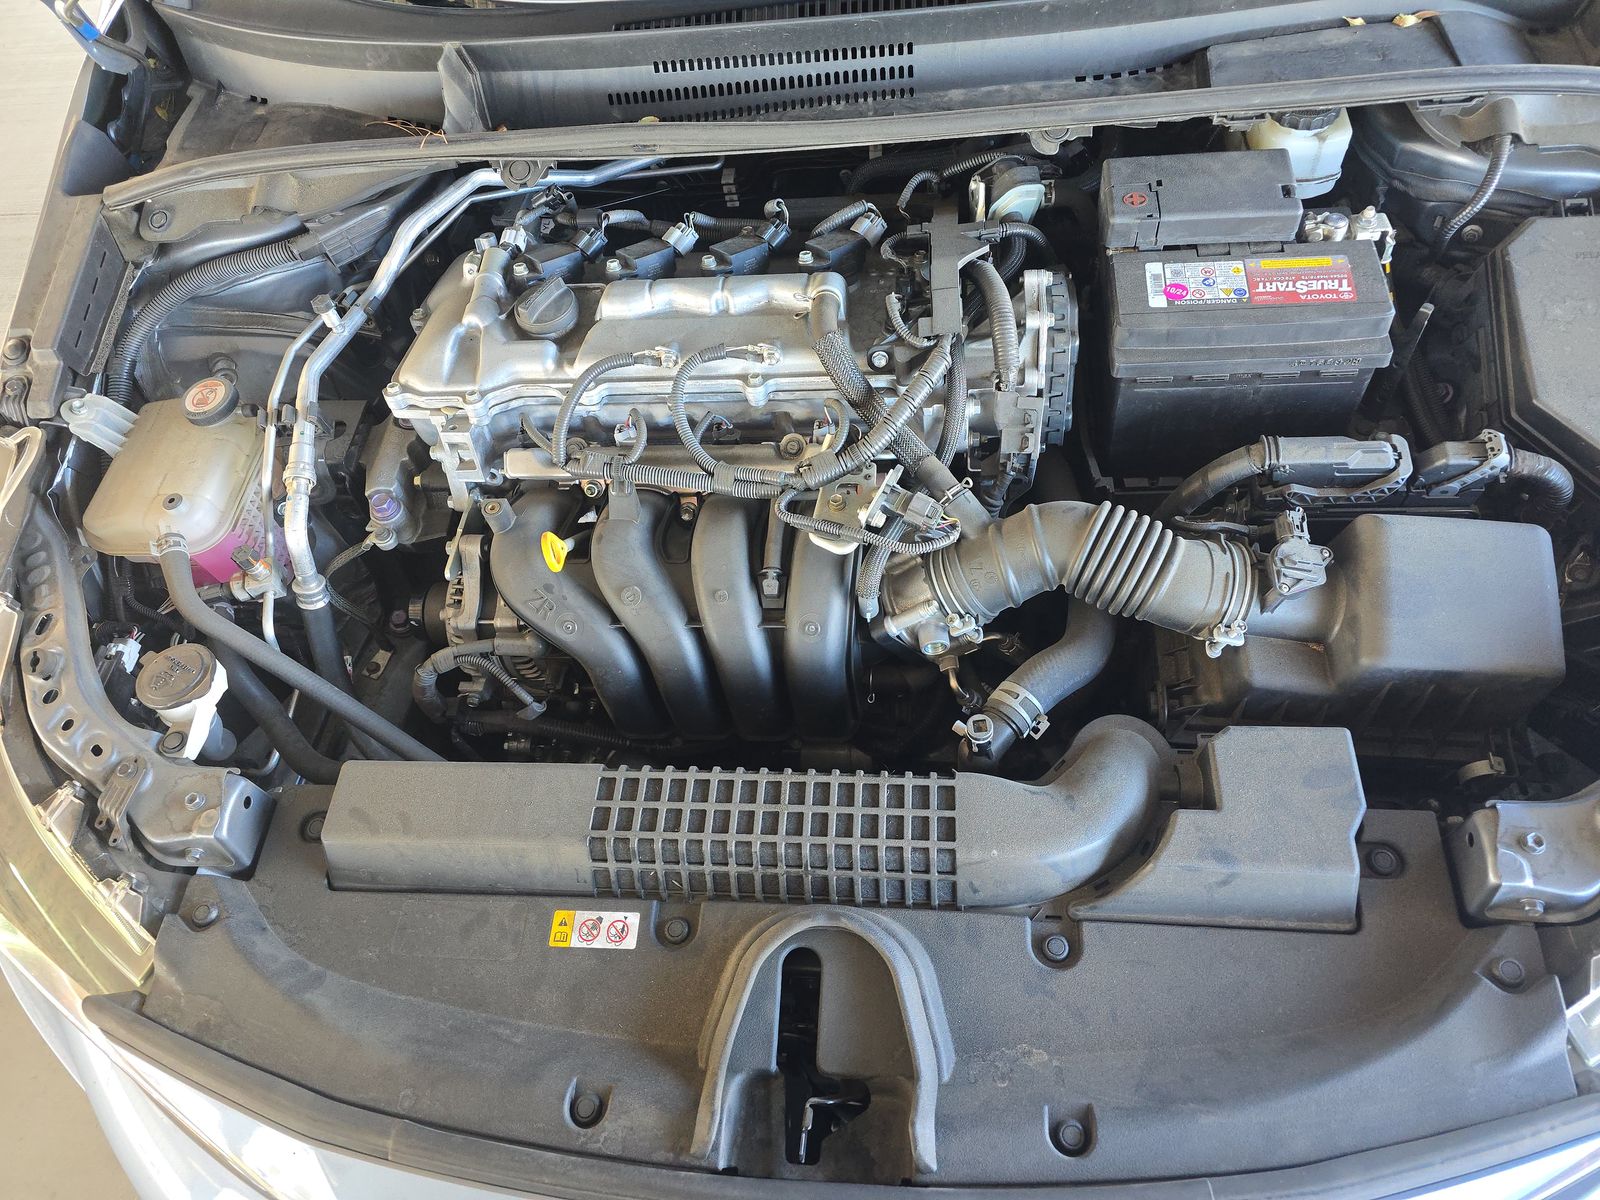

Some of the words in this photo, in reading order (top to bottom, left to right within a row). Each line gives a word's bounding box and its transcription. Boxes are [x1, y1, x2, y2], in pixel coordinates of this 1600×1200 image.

[1166, 286, 1188, 297] 10/24
[1255, 278, 1352, 294] TRUESTART
[526, 588, 558, 622] ZR
